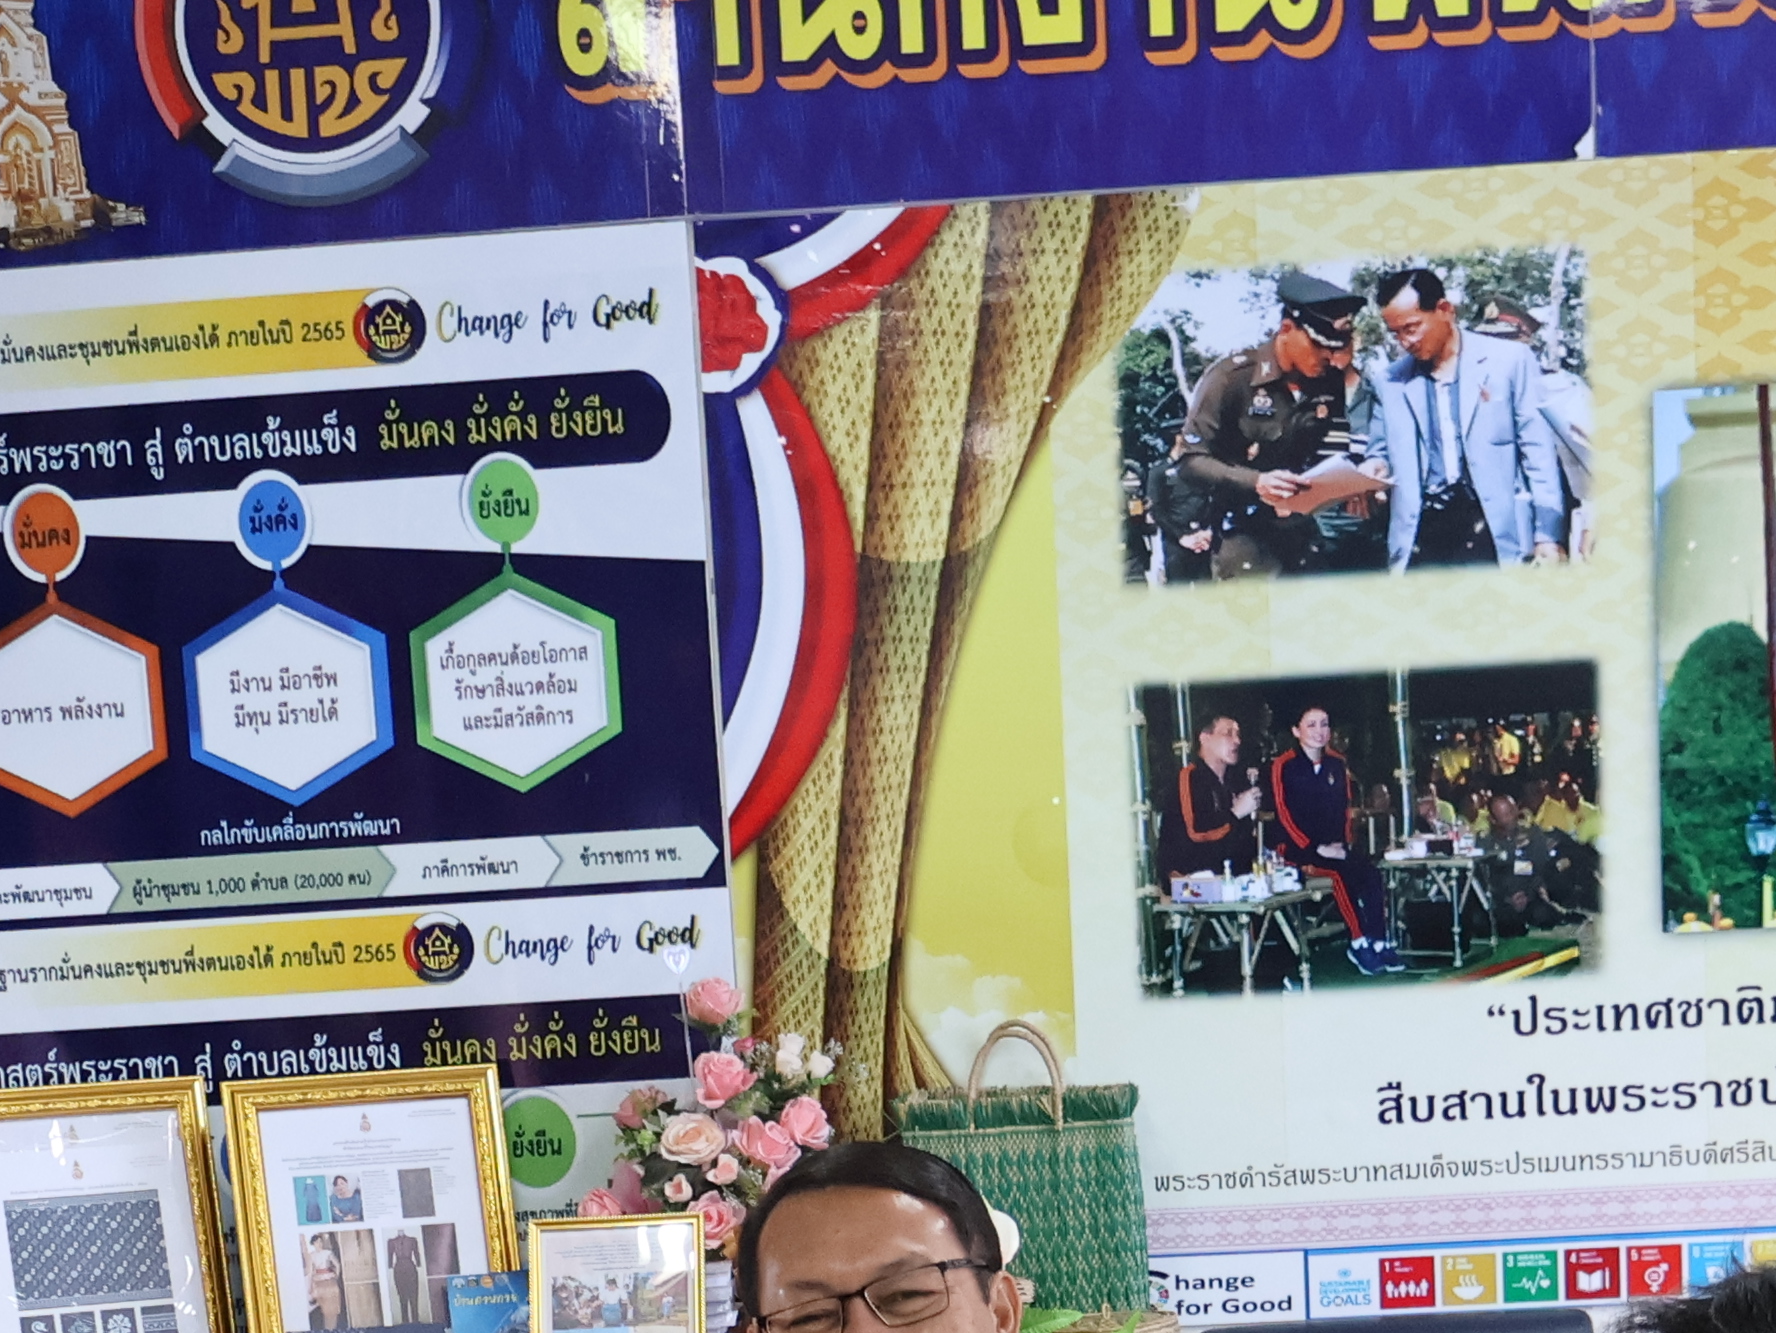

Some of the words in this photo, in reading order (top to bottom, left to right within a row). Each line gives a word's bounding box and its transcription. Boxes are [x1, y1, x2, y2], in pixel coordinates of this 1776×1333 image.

[436, 300, 528, 344] Change
[540, 298, 577, 343] for
[592, 286, 660, 330] Good
[226, 318, 294, 349] ภายในปี
[300, 320, 346, 343] 2565
[144, 427, 164, 480] สู่
[173, 408, 358, 464] ตำบลเข้มแข็ง
[378, 397, 456, 451] มั่นคง
[466, 390, 539, 445] มั่งคั่ง
[549, 386, 625, 438] ยั่งยืน
[248, 497, 299, 535] มั่งคั่ง
[477, 482, 531, 520] ยั่งยืน
[17, 505, 72, 553] มั่นคง
[439, 640, 589, 677] เกื้อกูลคนด้อยโอกาส
[229, 669, 273, 695] มีงาน
[278, 665, 339, 692] มีอาชีพ
[453, 669, 578, 702] รักษาสิ่งแวดล้อม
[0, 701, 52, 726] อาหาร
[58, 693, 125, 724] พลังงาน
[233, 703, 272, 735] มีทุน
[277, 696, 339, 726] มีรายได้
[462, 705, 575, 732] และมีสวัสดิการ
[198, 815, 403, 849] กลไกขับเคลื่อนการพัฒนา
[420, 856, 520, 881] ภาคีการพัฒนา
[577, 844, 651, 869] ข้าราชการ
[131, 872, 202, 904] ผู้นำชุมชน
[205, 876, 246, 899] 1,000
[250, 870, 290, 895] ตำบล
[293, 869, 343, 894] (20,000
[482, 923, 574, 967] Change
[585, 923, 622, 964] for
[634, 910, 702, 953] Good
[279, 940, 350, 974] ภายในปี
[353, 941, 398, 965] 2565
[223, 1027, 402, 1078] ตำบลเข้มแข็ง
[421, 1021, 498, 1068] มั่นคง
[507, 1014, 578, 1063] มั่งคั่ง
[588, 1009, 662, 1057] ยั่งยืน
[511, 1124, 563, 1159] ยั่งยืน
[1174, 1298, 1214, 1317] for
[1221, 1294, 1293, 1315] Good
[1319, 1294, 1373, 1308] GOALS
